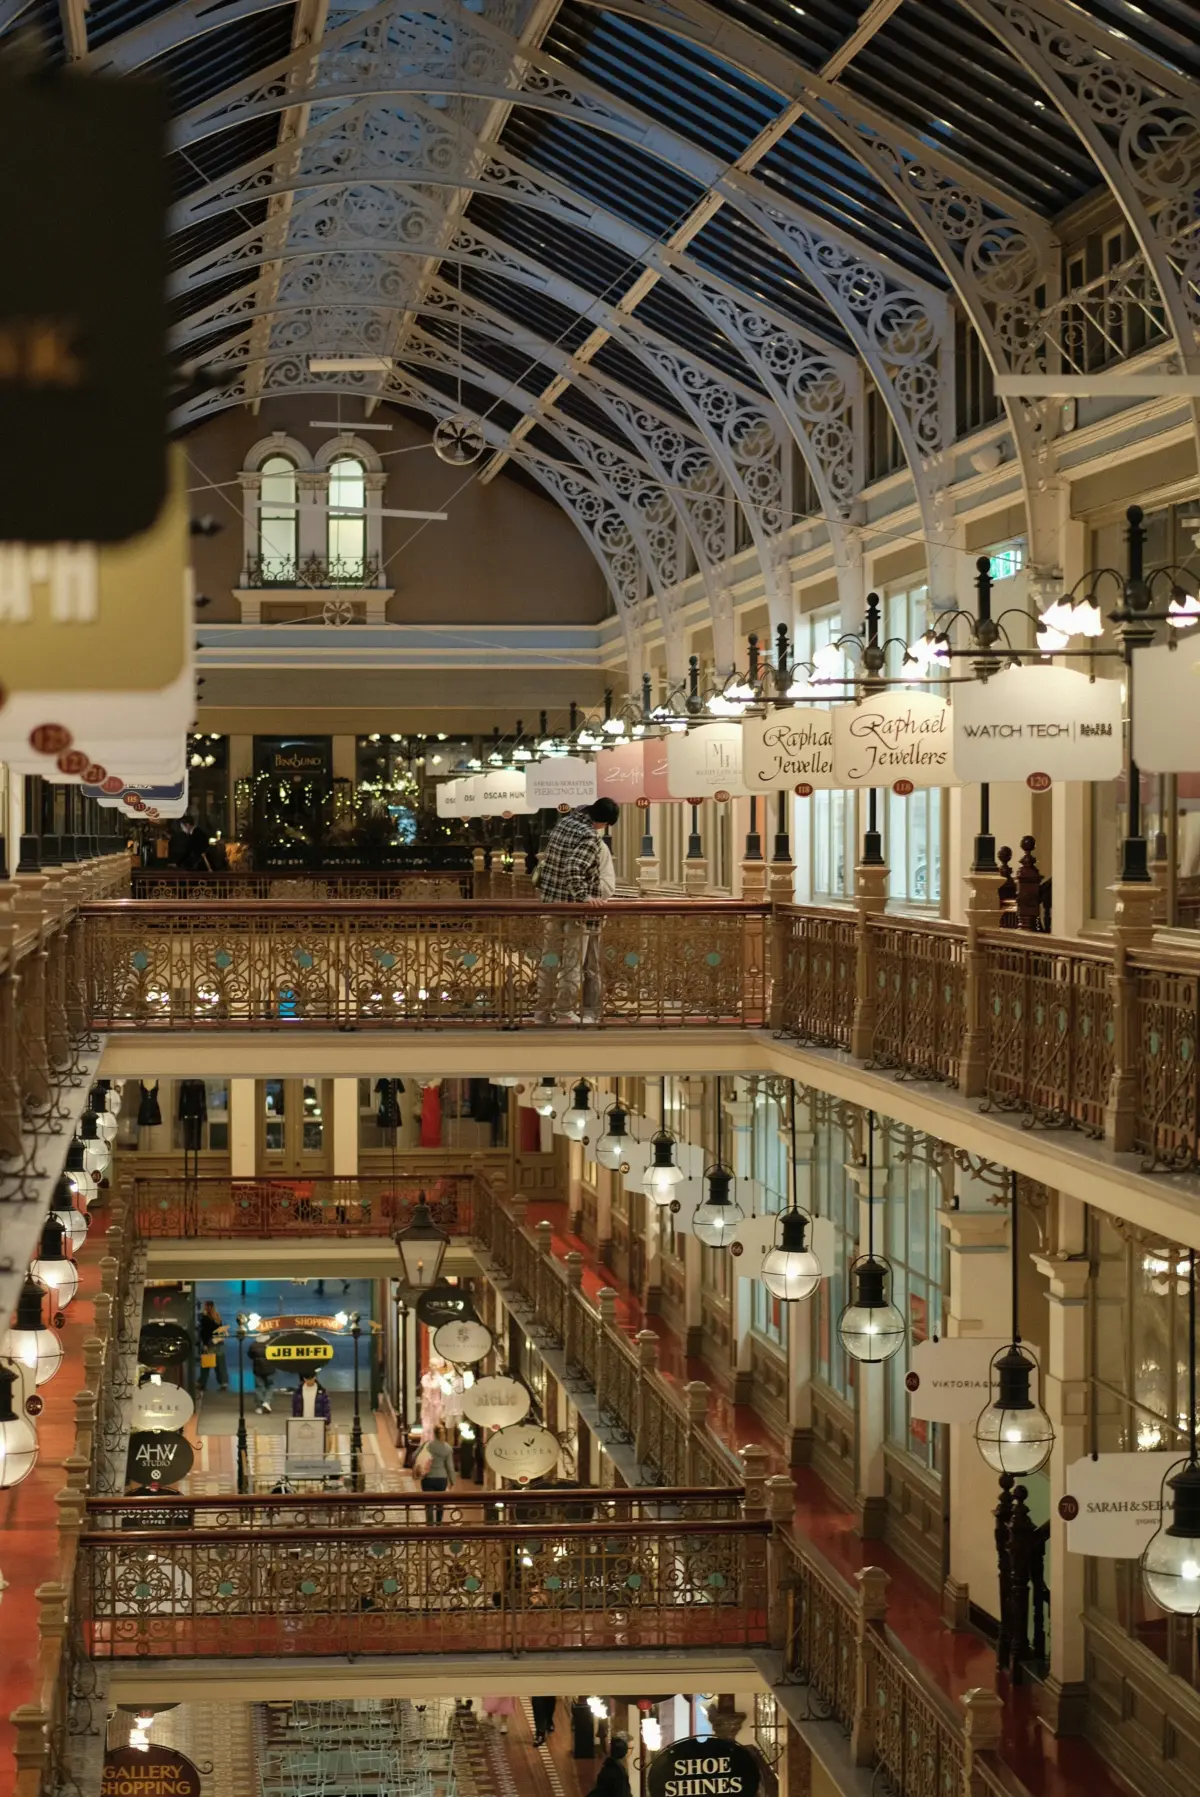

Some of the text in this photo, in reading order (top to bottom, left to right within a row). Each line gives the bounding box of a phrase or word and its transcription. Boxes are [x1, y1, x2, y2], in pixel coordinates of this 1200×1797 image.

[963, 723, 1069, 738] WATCH TECH
[848, 739, 948, 779] Jewellers
[1029, 776, 1048, 787] 120
[127, 795, 137, 803] 115
[509, 791, 525, 799] HUN
[272, 1347, 292, 1357] JB
[135, 1443, 178, 1461] AHW
[1062, 1502, 1075, 1513] 70
[103, 1765, 184, 1780] GALLERY
[674, 1757, 732, 1777] SHOE
[100, 1781, 191, 1796] SHOPPING
[664, 1776, 742, 1797] SHINES
